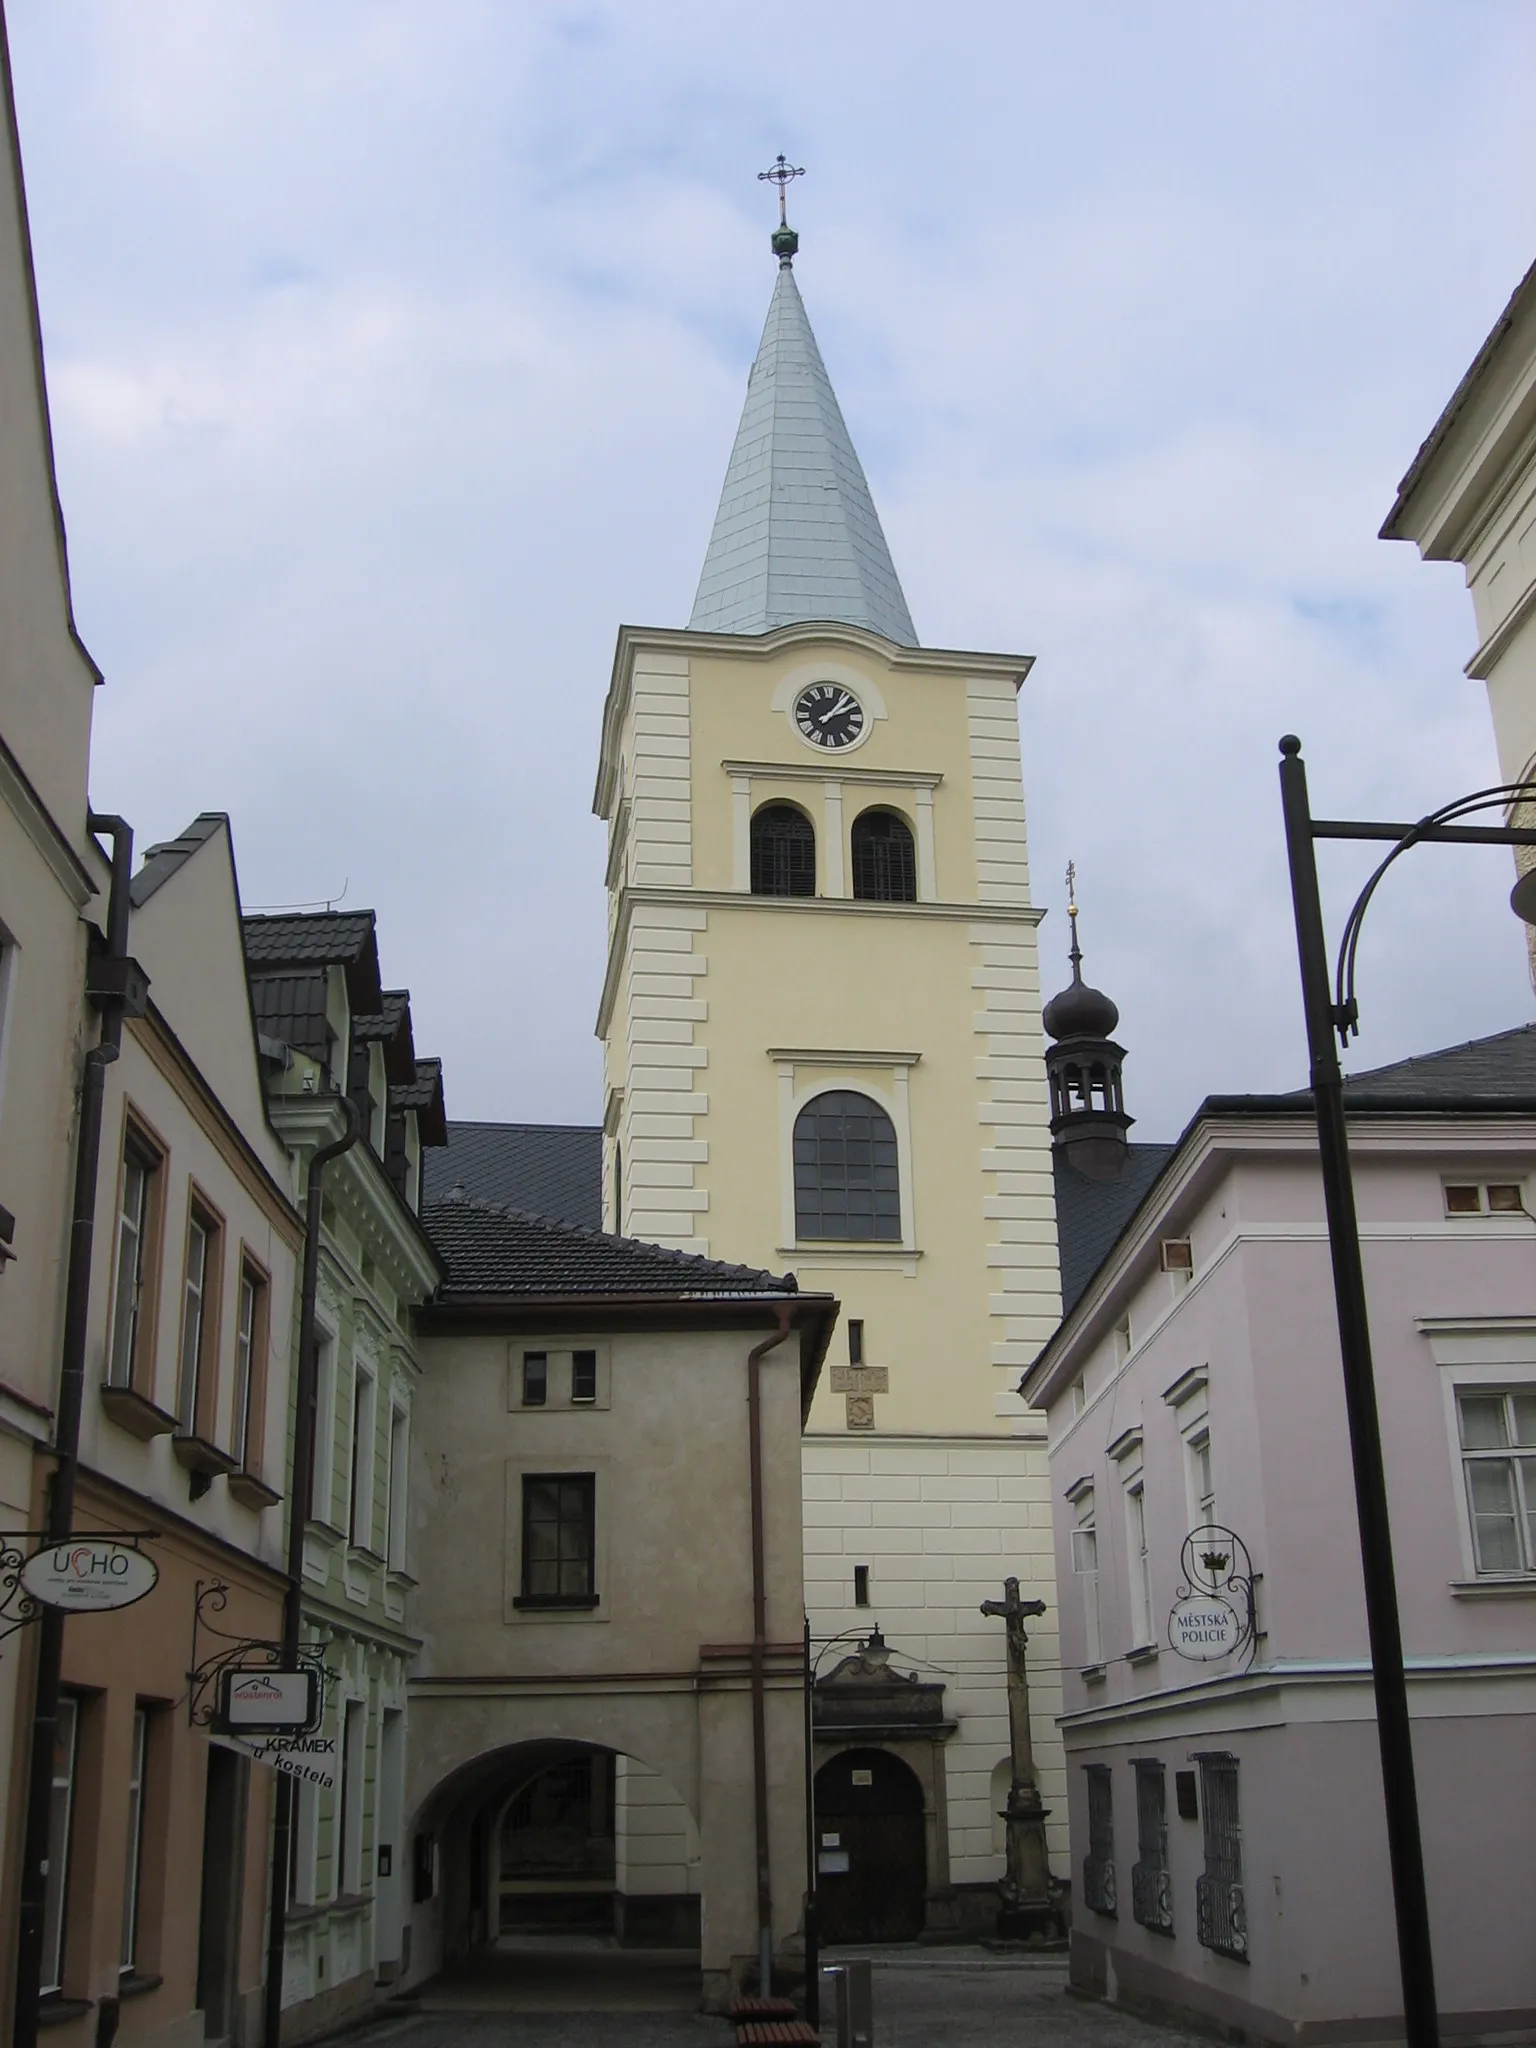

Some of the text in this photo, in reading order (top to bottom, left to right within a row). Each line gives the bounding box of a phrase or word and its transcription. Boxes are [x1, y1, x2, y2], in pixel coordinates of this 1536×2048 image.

[53, 1547, 129, 1577] UCHO
[1177, 1611, 1229, 1628] MĚSTSKÁ
[1181, 1629, 1227, 1643] POLICIE
[273, 1753, 334, 1788] kostela
